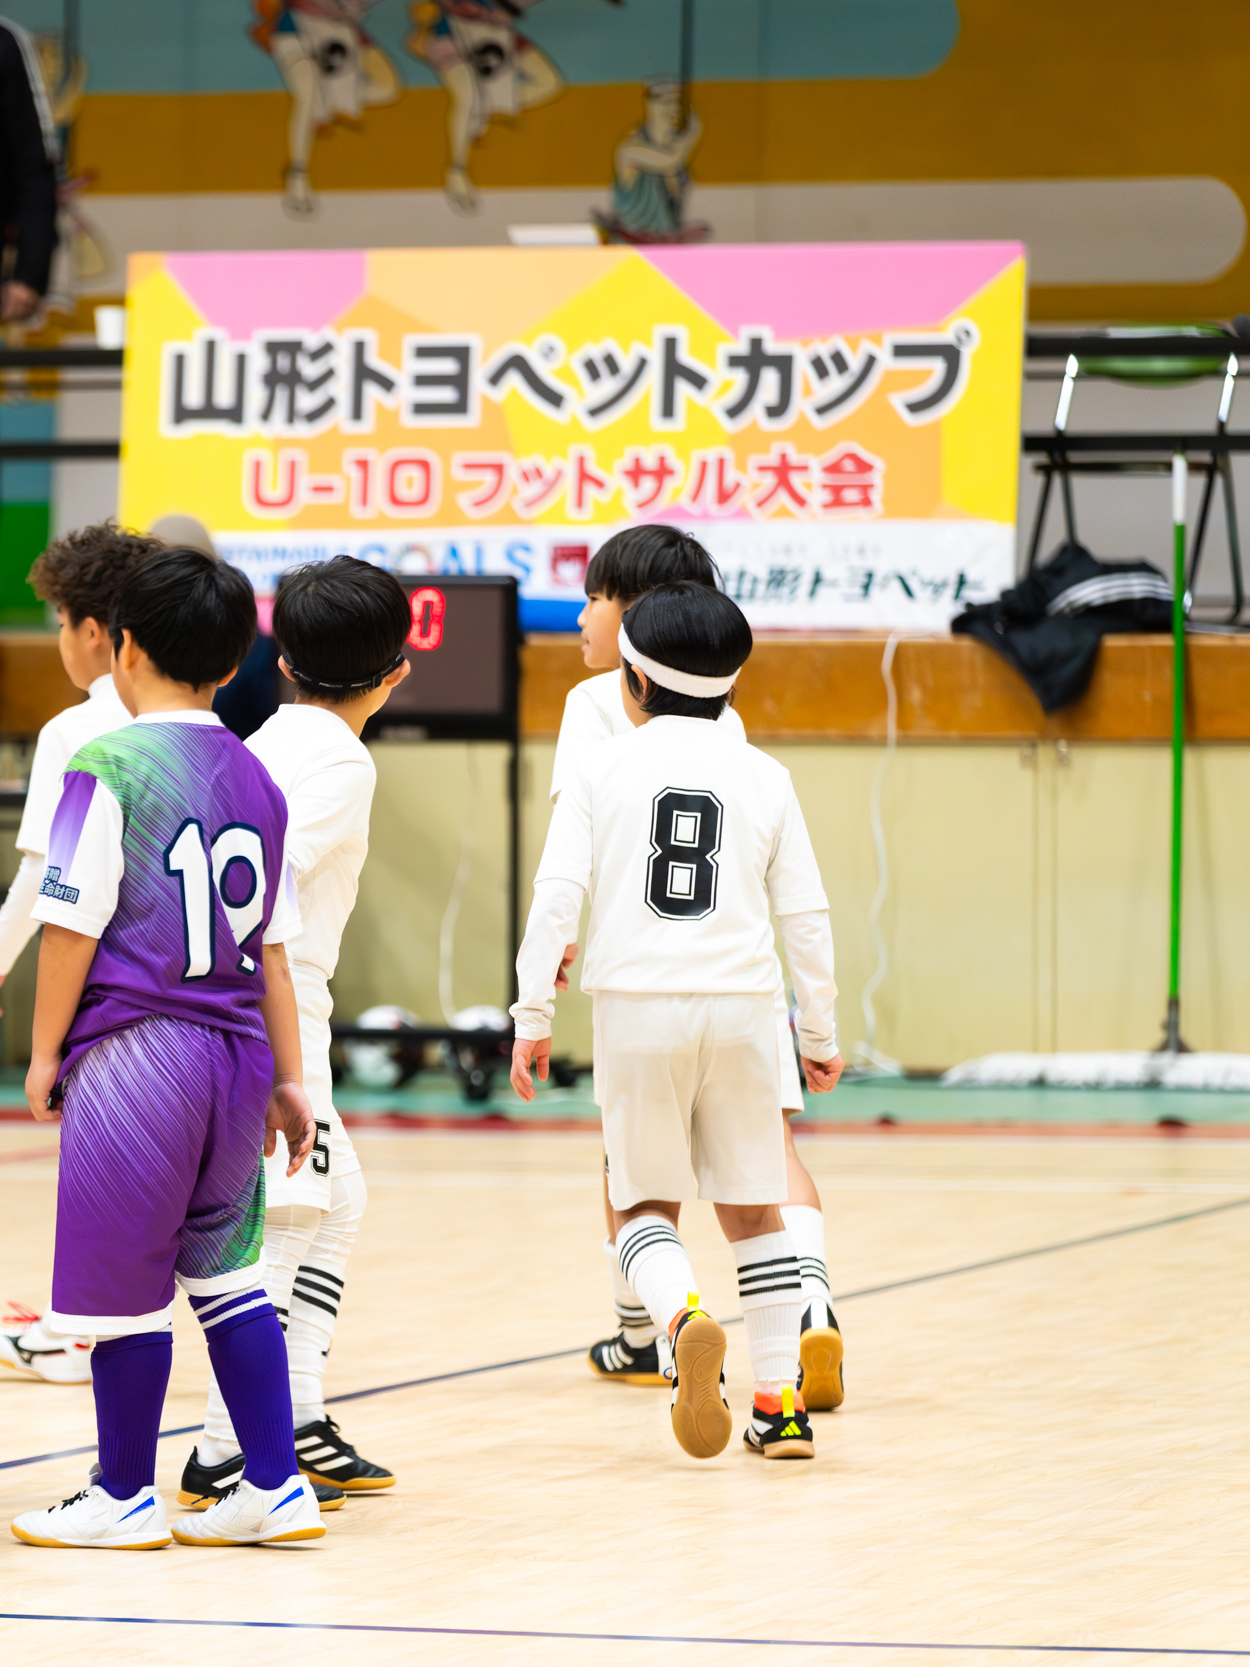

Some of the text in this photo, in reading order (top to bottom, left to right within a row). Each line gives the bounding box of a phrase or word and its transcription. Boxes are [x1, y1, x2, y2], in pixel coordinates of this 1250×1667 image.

[168, 321, 976, 430] 山形トヨペットカップ
[249, 450, 880, 513] U-10 フットサル大会
[720, 565, 983, 602] 山形トヨペット
[409, 587, 446, 651] 0
[644, 786, 724, 921] 8
[163, 818, 266, 984] 19
[310, 1119, 331, 1177] 5
